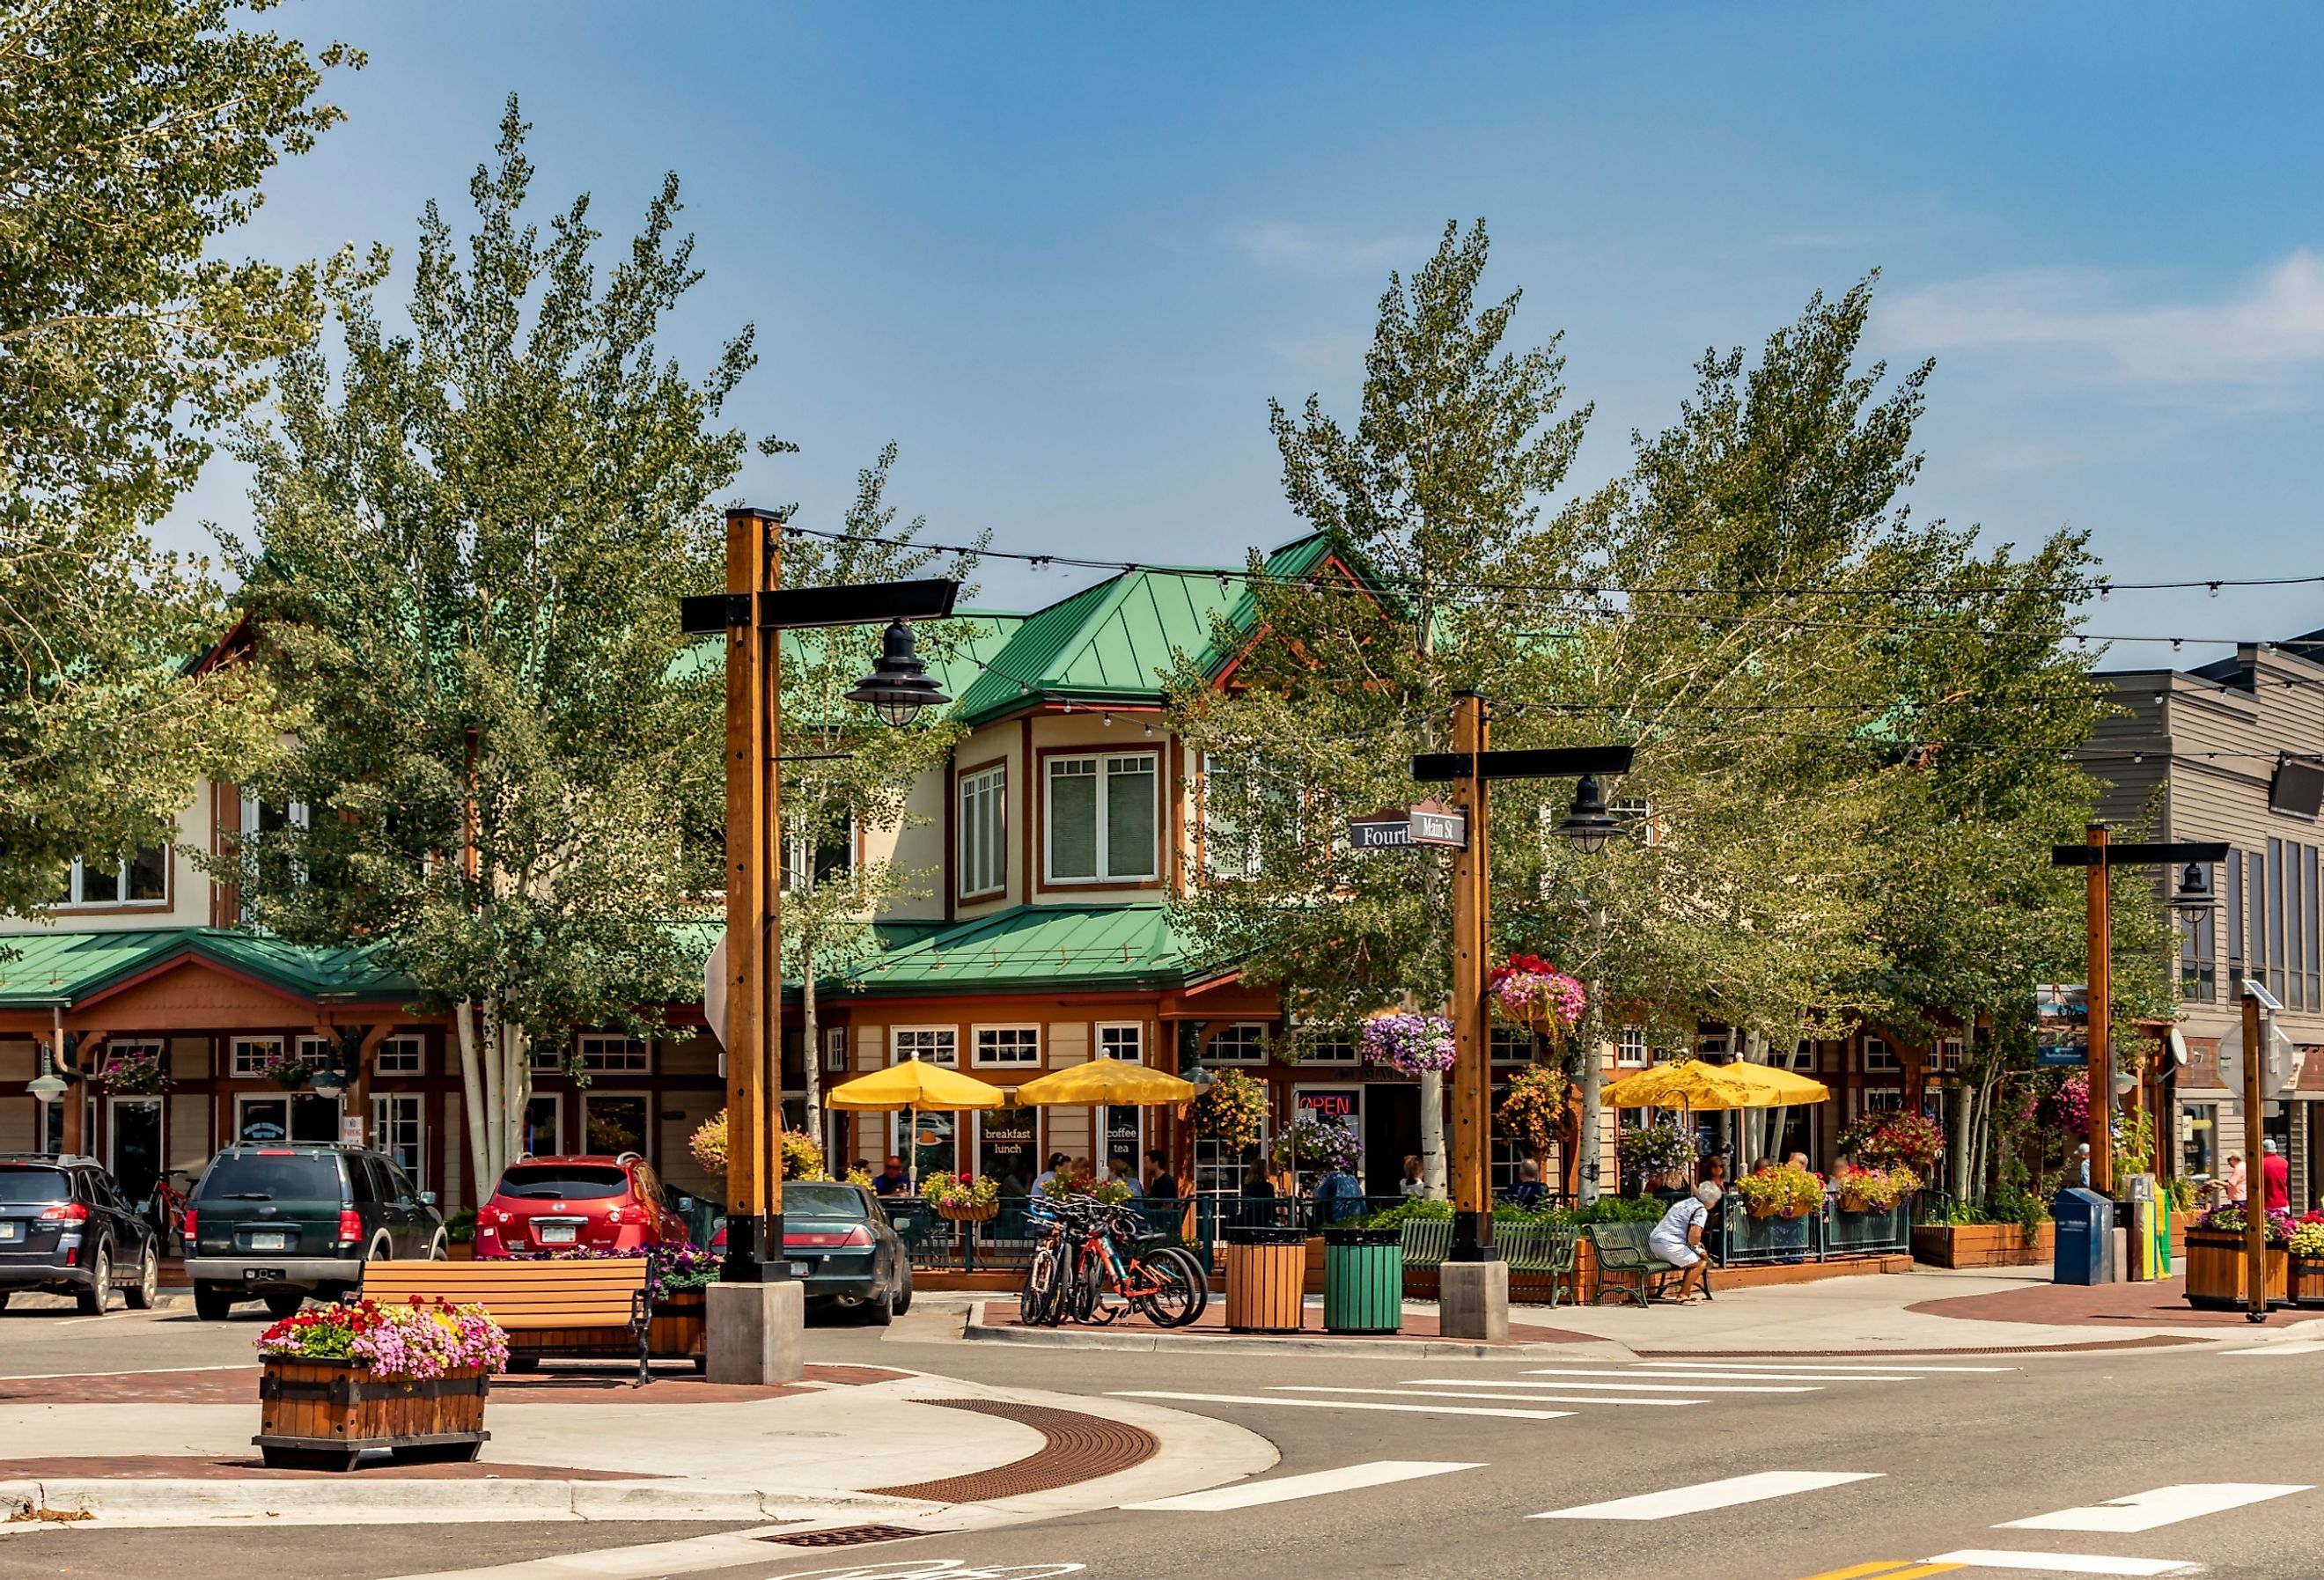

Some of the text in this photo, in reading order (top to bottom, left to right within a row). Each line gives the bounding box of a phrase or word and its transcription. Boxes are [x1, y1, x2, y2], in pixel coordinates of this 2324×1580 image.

[1423, 817, 1453, 839] Main St
[1299, 1096, 1350, 1115] OPEN
[985, 1128, 1032, 1139] breakfast
[1106, 1128, 1137, 1138] coffee
[995, 1143, 1022, 1154] lunch
[1114, 1144, 1129, 1153] tea
